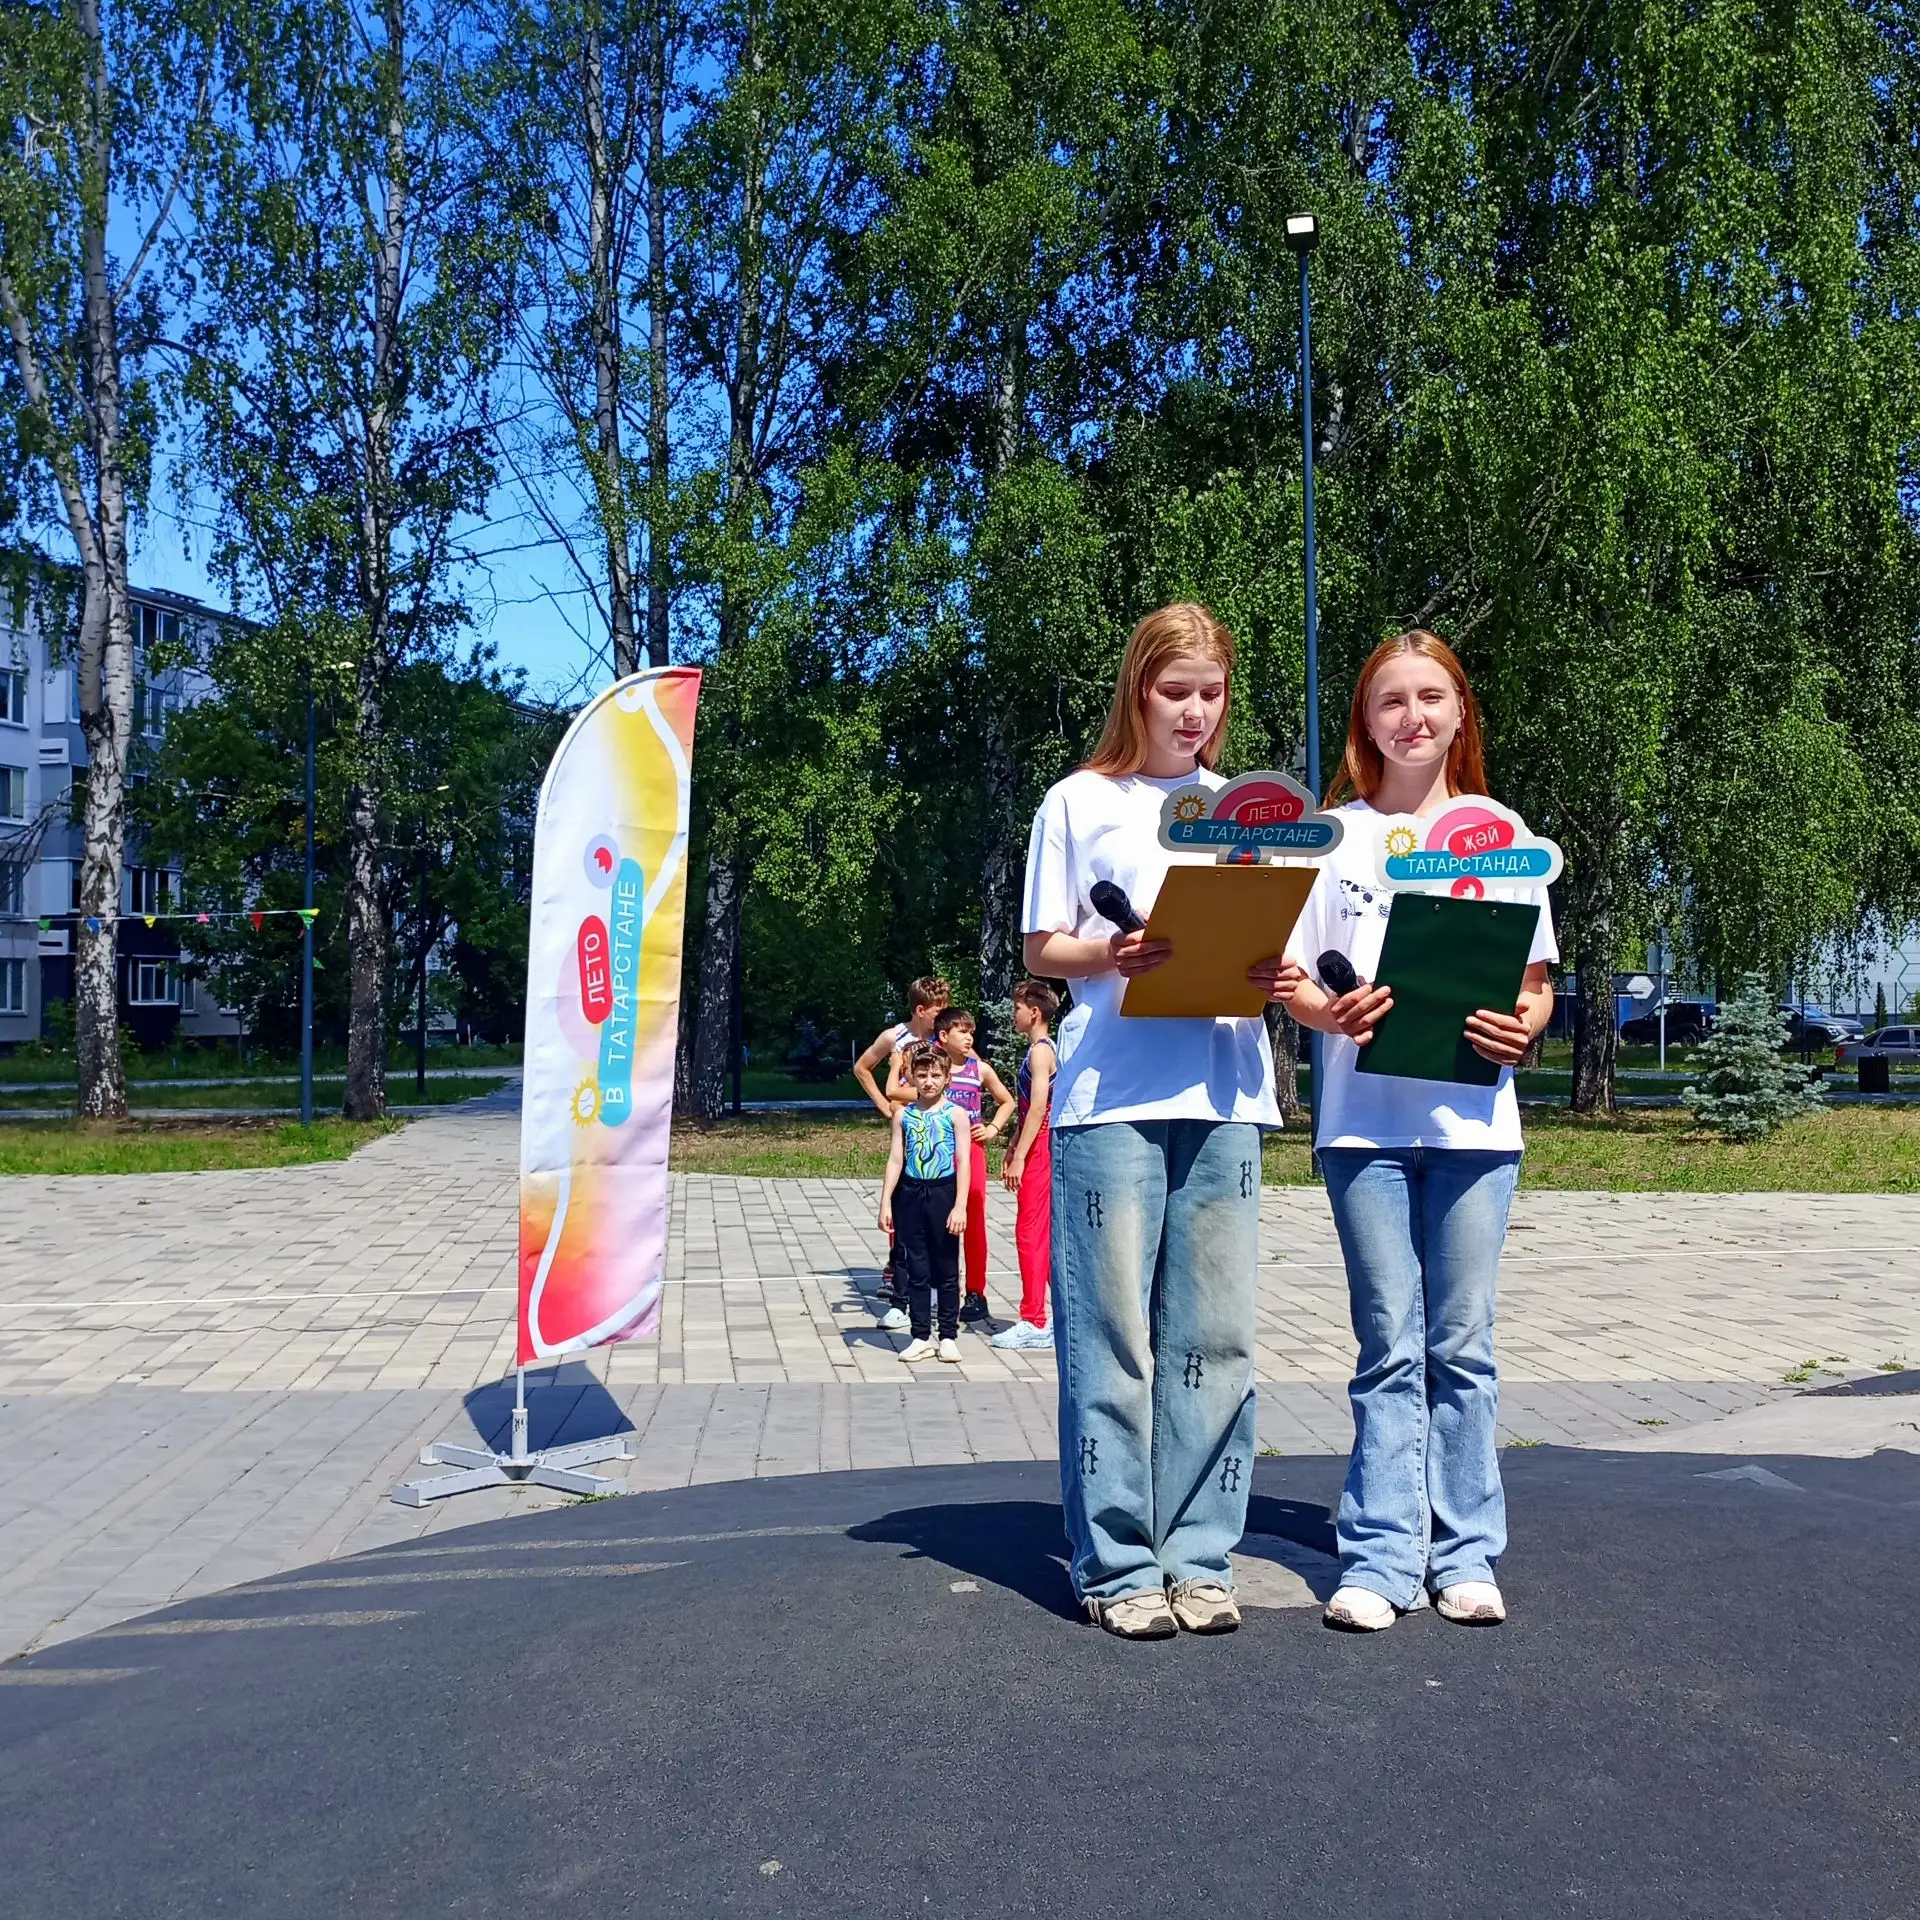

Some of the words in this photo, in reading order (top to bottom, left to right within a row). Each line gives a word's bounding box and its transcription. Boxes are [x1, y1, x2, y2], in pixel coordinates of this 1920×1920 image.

[1247, 802, 1293, 822] ЛЕТО
[1182, 824, 1194, 838] В
[1207, 825, 1320, 843] ТАТАРСТАНЕ
[1406, 855, 1531, 874] ТАТАРСТАНДА
[584, 932, 606, 1004] ЛЕТО
[607, 880, 637, 1065] ТАТАРСТАНЕ
[605, 1086, 625, 1104] В
